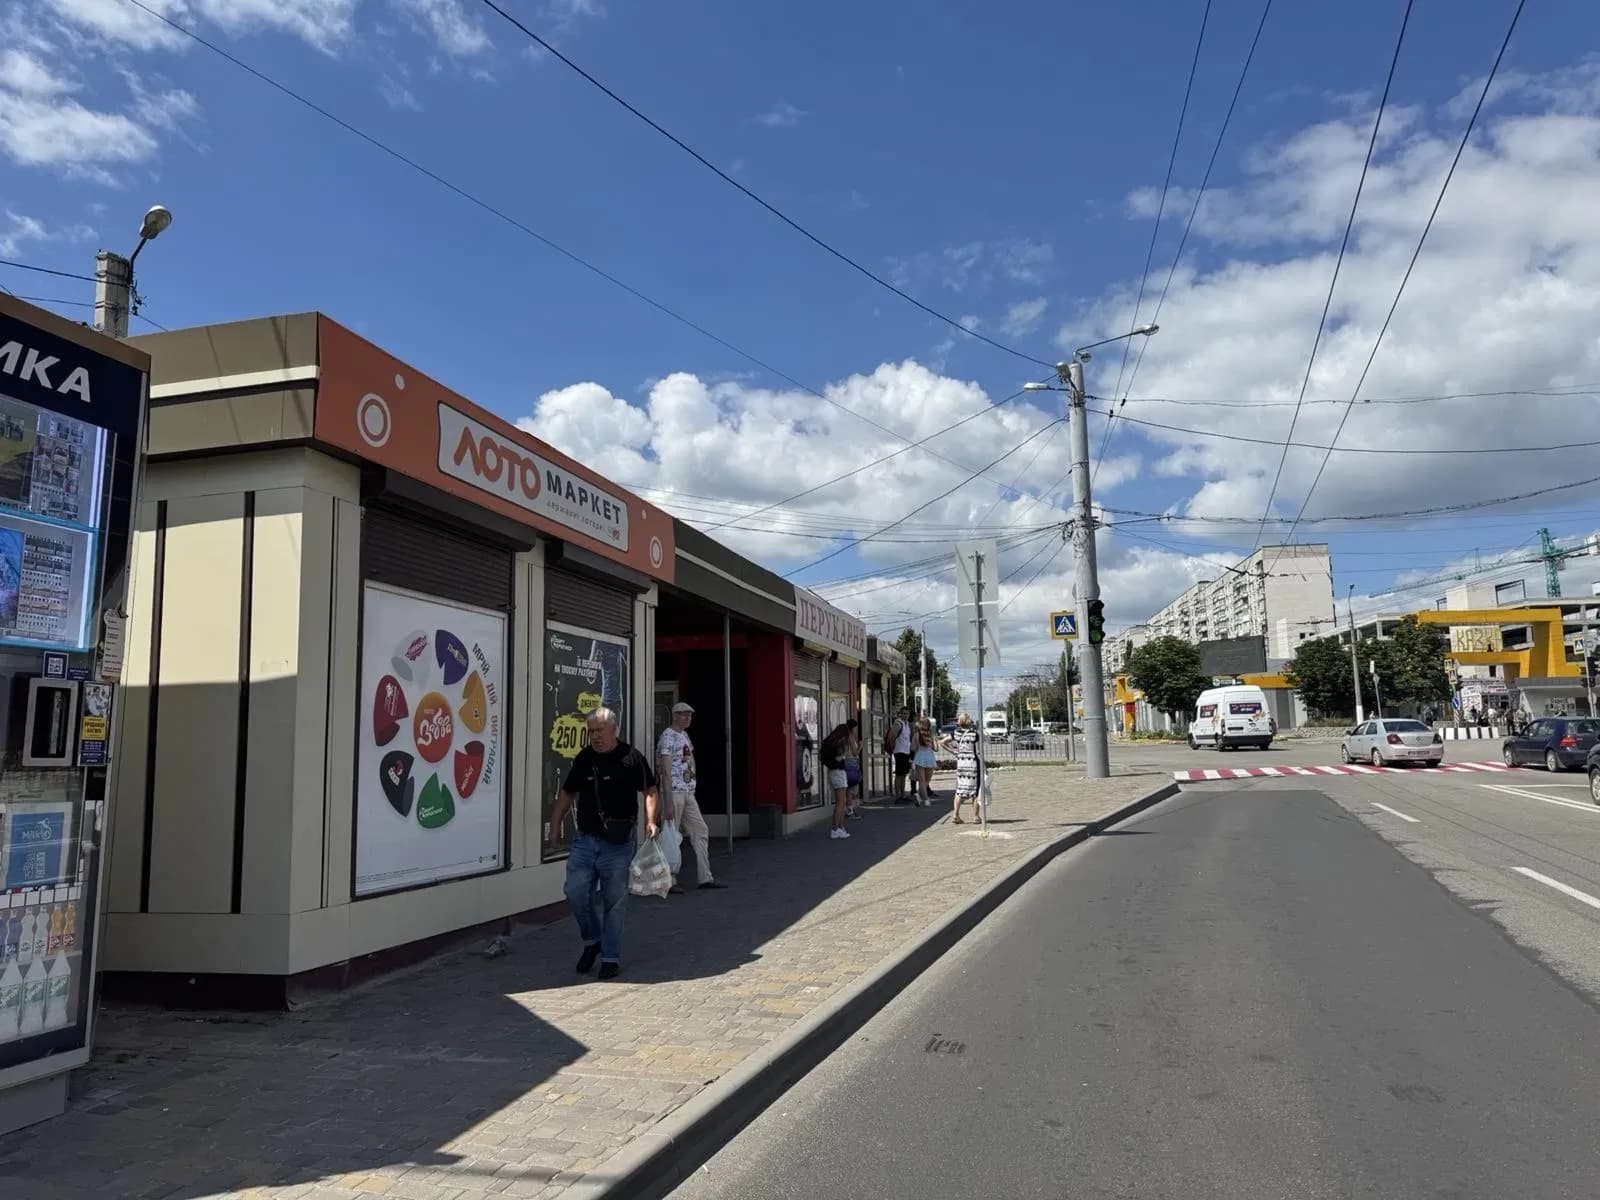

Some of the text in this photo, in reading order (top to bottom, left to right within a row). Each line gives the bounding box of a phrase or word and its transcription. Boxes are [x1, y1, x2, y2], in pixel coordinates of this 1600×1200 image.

[453, 426, 621, 524] ЛОТО МАРКЕТ
[799, 598, 865, 653] ПЕРУКАРНЯ
[417, 707, 452, 747] Забава
[555, 726, 577, 749] 250
